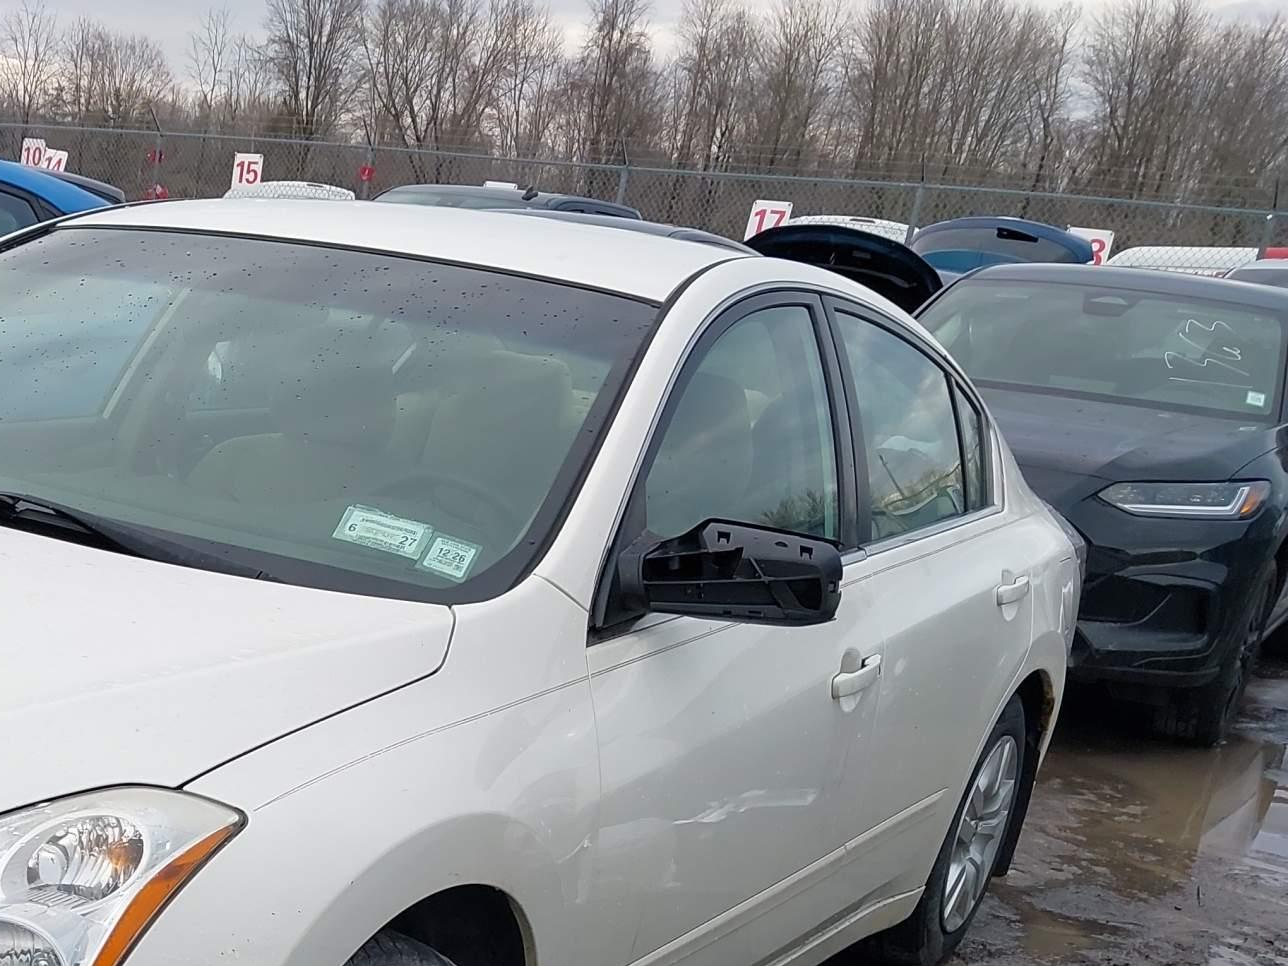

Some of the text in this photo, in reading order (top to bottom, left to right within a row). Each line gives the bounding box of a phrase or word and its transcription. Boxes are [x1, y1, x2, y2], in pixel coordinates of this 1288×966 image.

[24, 146, 42, 166] 10
[236, 160, 259, 185] 15
[753, 208, 787, 233] 17
[348, 523, 358, 532] 6
[397, 535, 418, 547] 27
